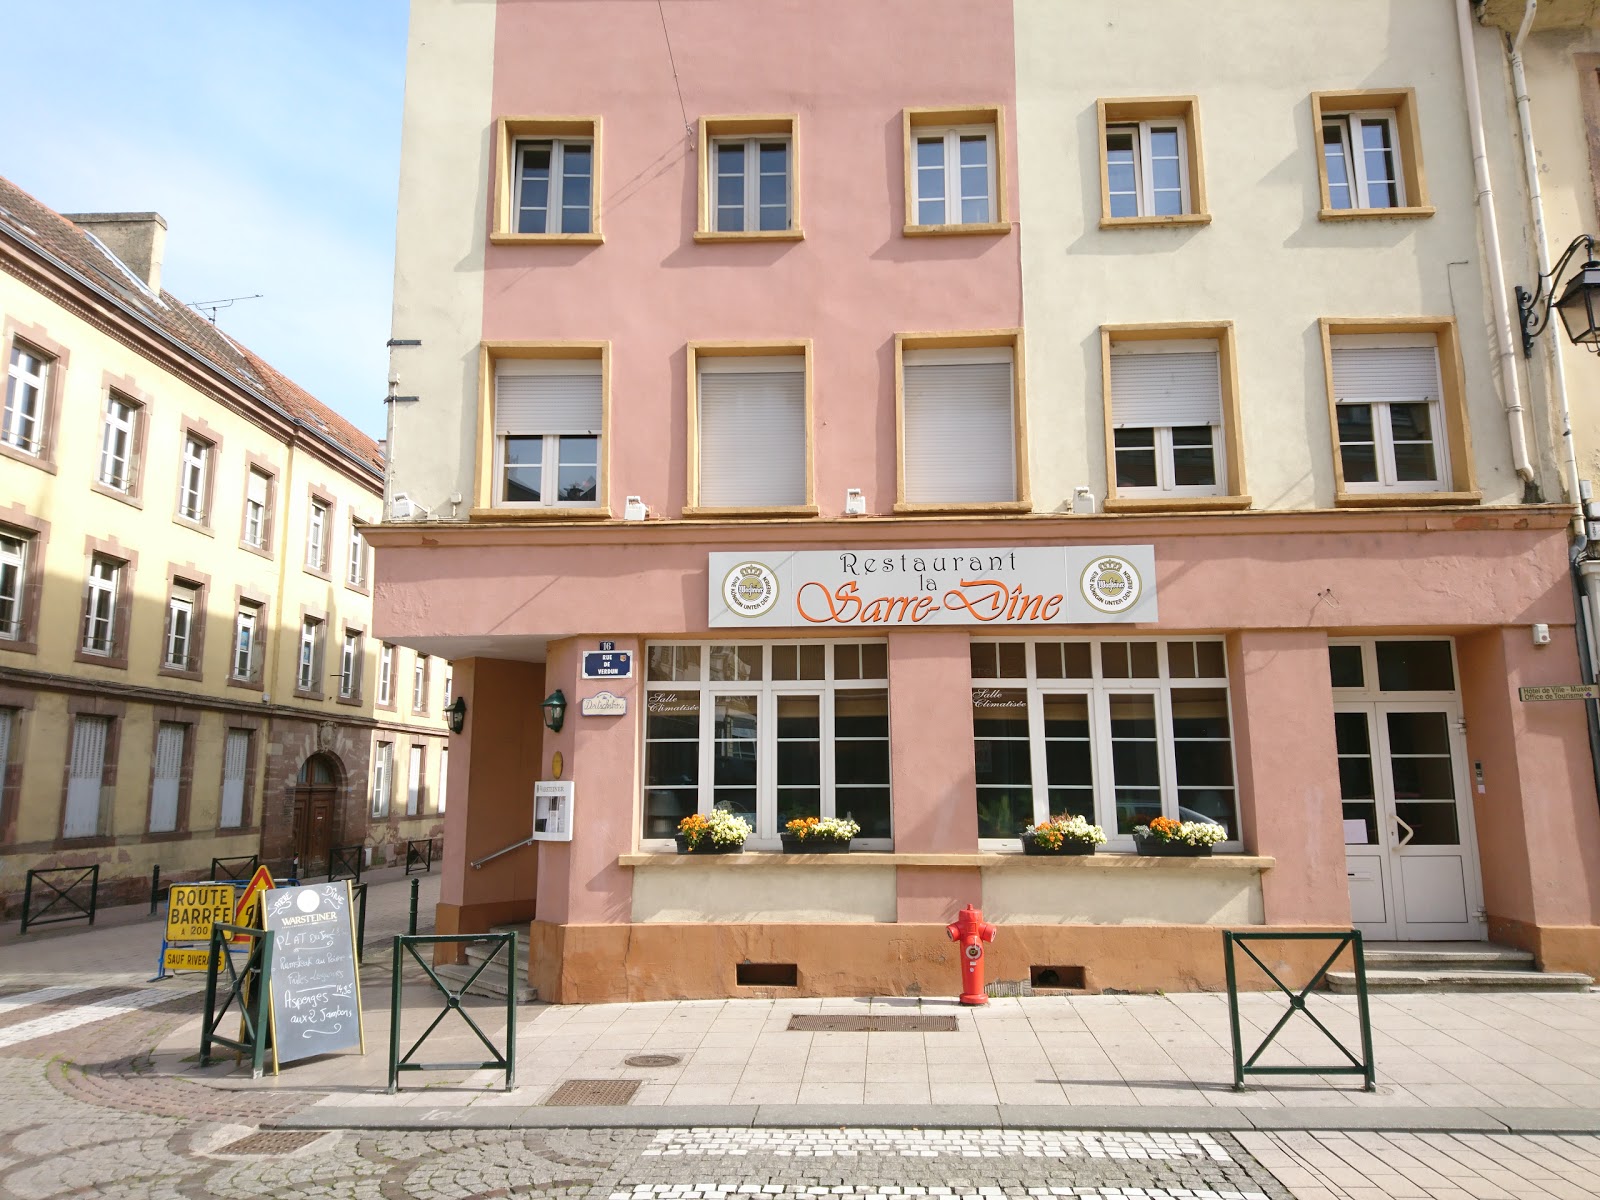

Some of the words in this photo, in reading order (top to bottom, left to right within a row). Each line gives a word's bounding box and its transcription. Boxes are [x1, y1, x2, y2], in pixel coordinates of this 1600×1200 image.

[839, 552, 1016, 576] Restaurant
[919, 574, 938, 591] la
[796, 578, 1064, 623] Sarre-Dîne
[1104, 598, 1123, 606] UNTER
[603, 642, 612, 650] 16
[648, 692, 678, 703] Salle
[972, 688, 1003, 699] Salle
[176, 889, 228, 906] ROUTE
[171, 906, 230, 925] BARRÉE
[281, 911, 337, 926] WARSTEINER
[190, 926, 208, 935] 200
[276, 930, 307, 950] PLAT
[167, 954, 185, 965] SAUF
[187, 954, 222, 967] RIVERS
[315, 957, 326, 965] au
[284, 990, 328, 1010] Asperges
[290, 1014, 308, 1024] aux
[308, 1009, 317, 1024] 2
[319, 1005, 352, 1022] Jambons
